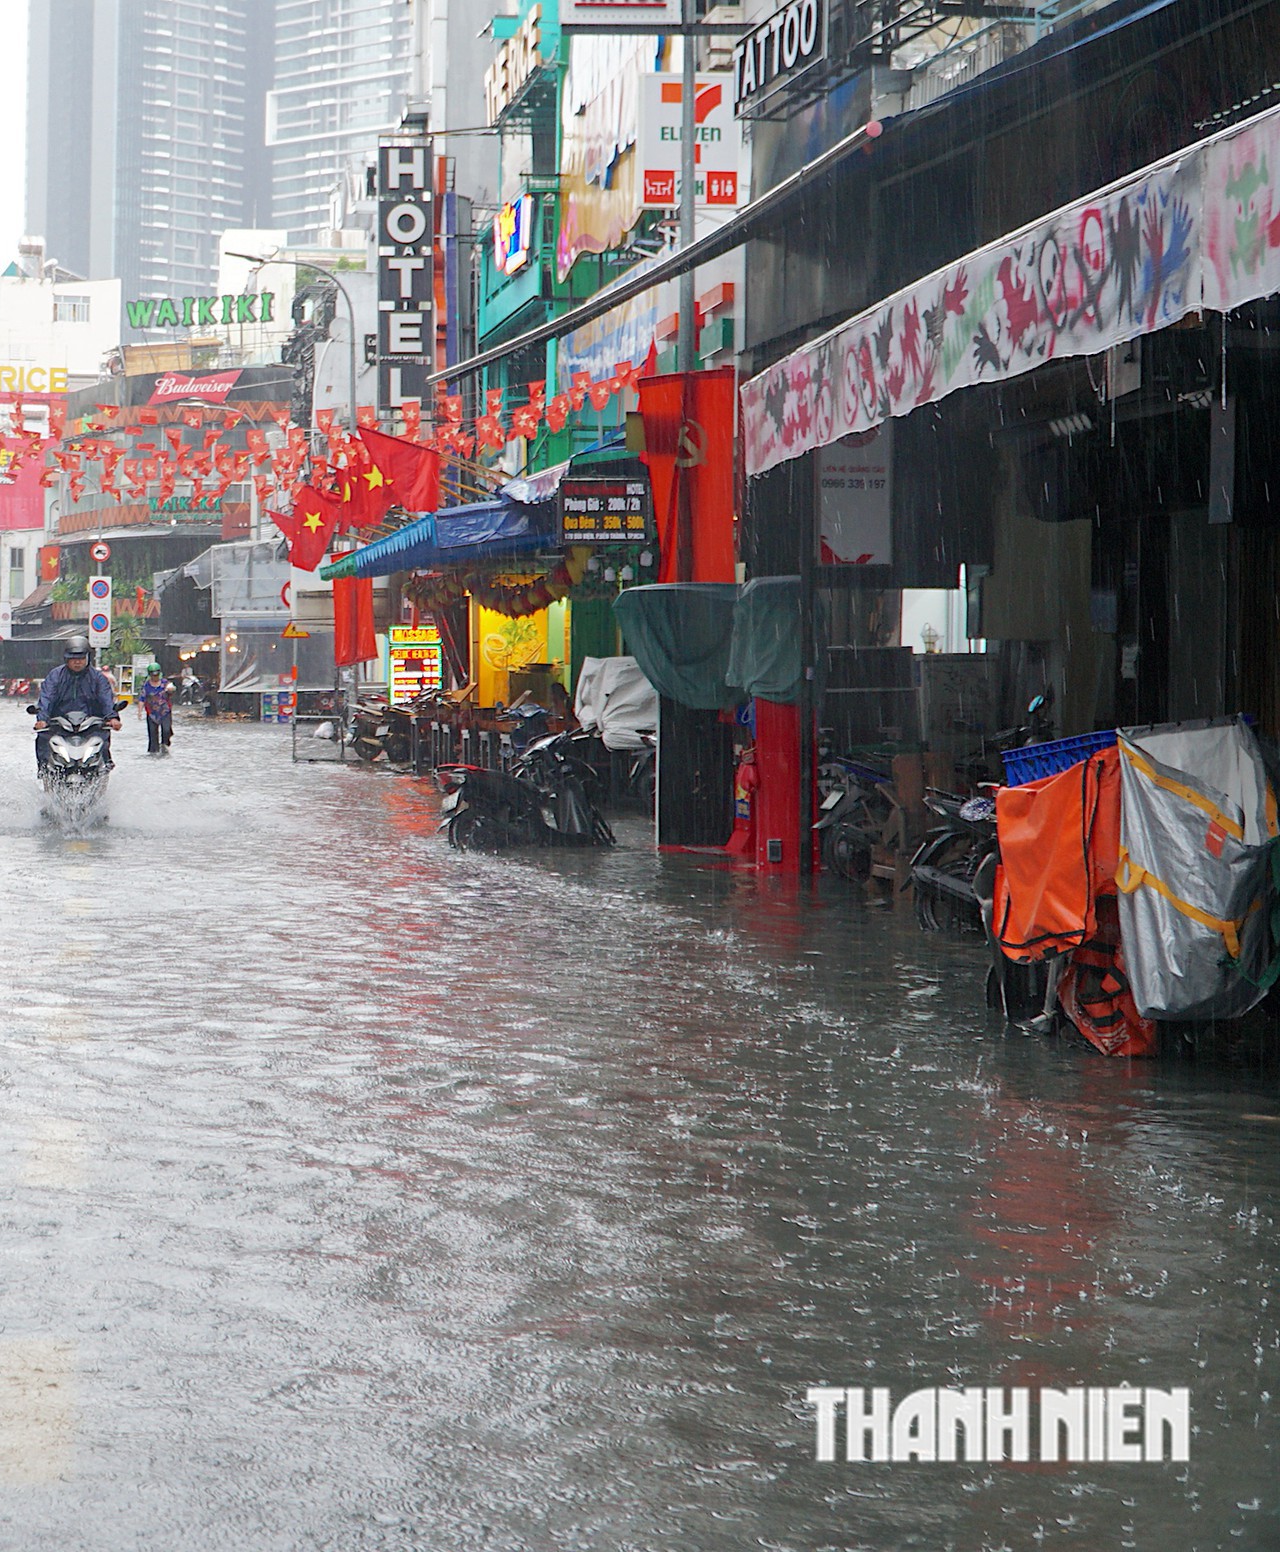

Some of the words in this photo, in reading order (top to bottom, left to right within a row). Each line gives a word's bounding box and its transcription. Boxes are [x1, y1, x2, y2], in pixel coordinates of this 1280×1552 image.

[732, 0, 817, 104] TATTOO
[661, 126, 722, 142] ELEn
[676, 180, 705, 195] 2H
[386, 147, 426, 408] HOTEL
[126, 291, 276, 329] WAIKIKI
[155, 377, 234, 396] Budweiser
[868, 479, 886, 489] 197
